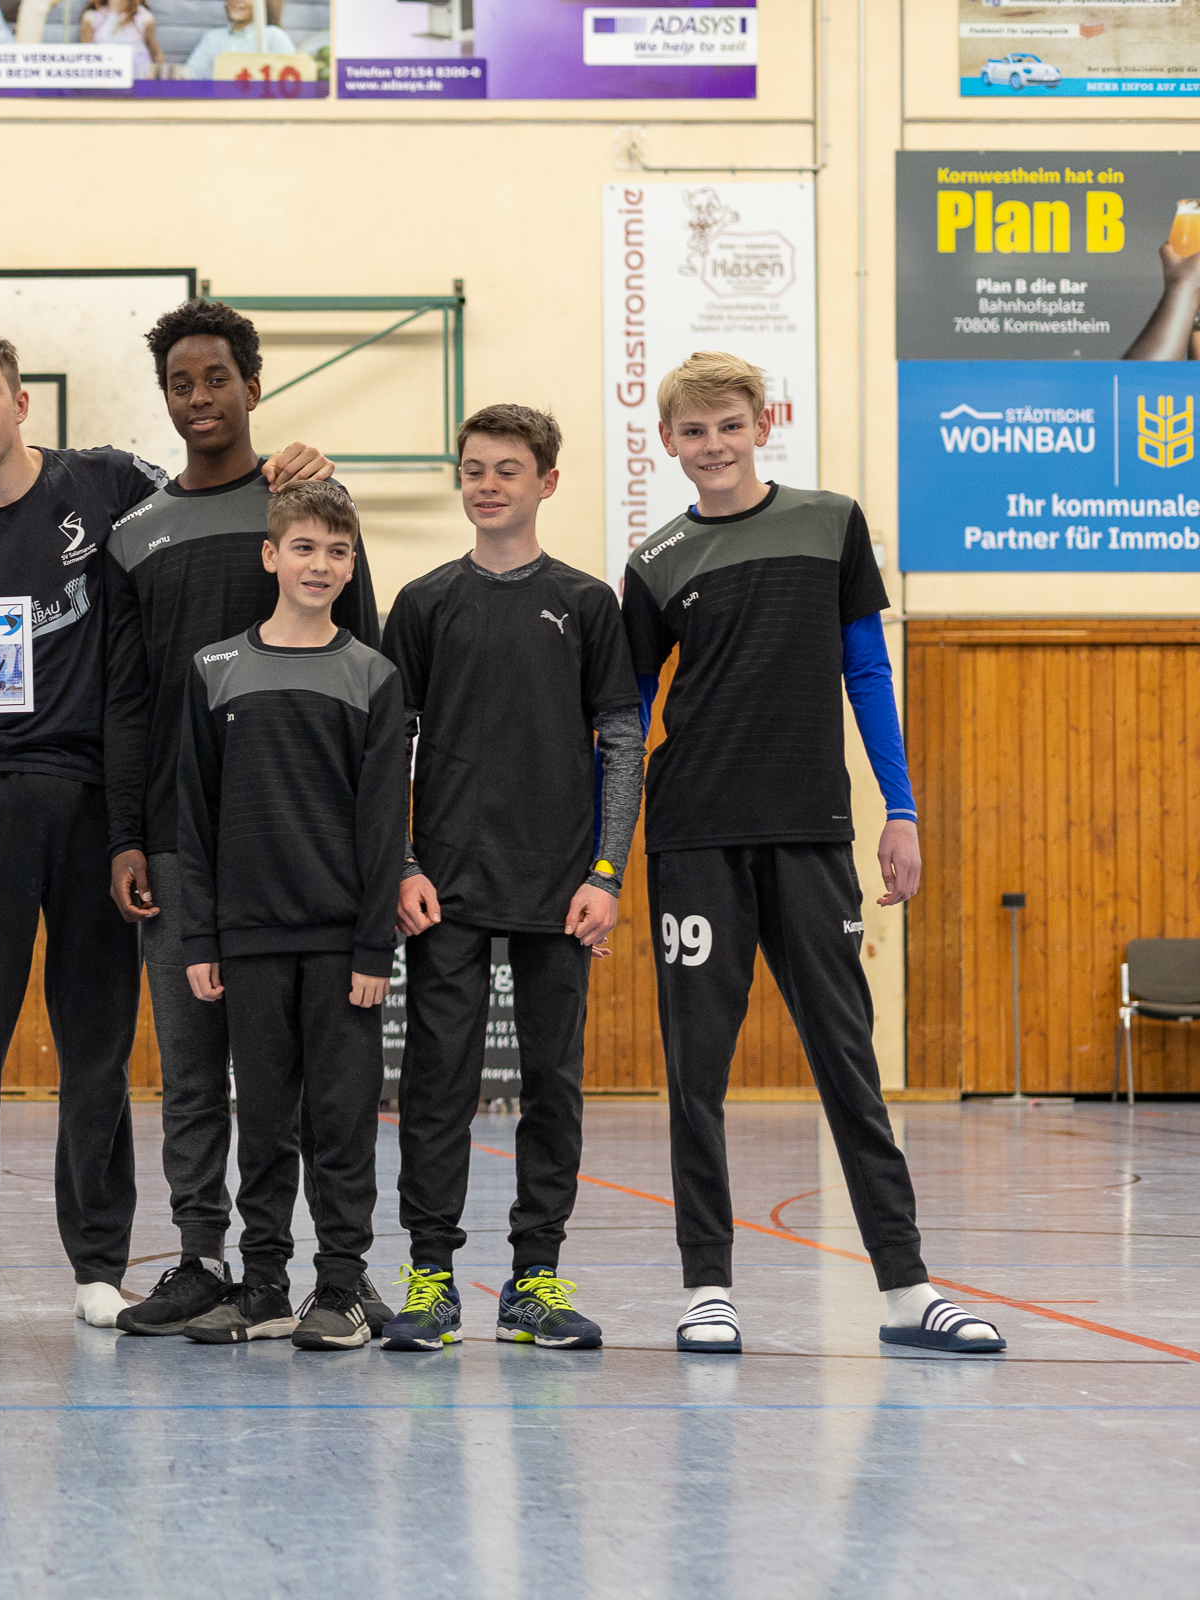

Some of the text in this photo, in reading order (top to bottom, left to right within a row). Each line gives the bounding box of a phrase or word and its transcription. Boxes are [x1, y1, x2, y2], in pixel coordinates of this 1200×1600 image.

[650, 16, 736, 35] ADASYS
[634, 41, 657, 51] We
[662, 41, 695, 53] help
[700, 41, 715, 51] to
[22, 53, 103, 63] VERKAUFEN
[6, 68, 40, 79] BEIM
[45, 69, 124, 79] KASSIEREN
[937, 167, 1124, 184] Kornwestheim hat ein
[937, 190, 1125, 254] Plan B
[712, 259, 784, 278] Hasen
[976, 278, 1088, 294] Plan B die Bar
[617, 188, 646, 407] Gastronomie
[978, 298, 1085, 317] Bahnhofsplatz
[953, 317, 1111, 333] 70806 Kornwestheim
[1005, 405, 1095, 423] STÄDTISCHE
[940, 426, 1096, 454] WOHNBAU
[1006, 493, 1200, 517] Ihr kommunale
[111, 503, 154, 531] Kempa
[148, 535, 171, 550] Manu
[640, 530, 686, 563] Kempa
[964, 526, 1060, 550] Partner
[1065, 525, 1103, 550] für
[60, 553, 69, 561] SV
[31, 600, 61, 625] NBAU
[203, 649, 239, 665] Kempa
[661, 912, 713, 967] 99
